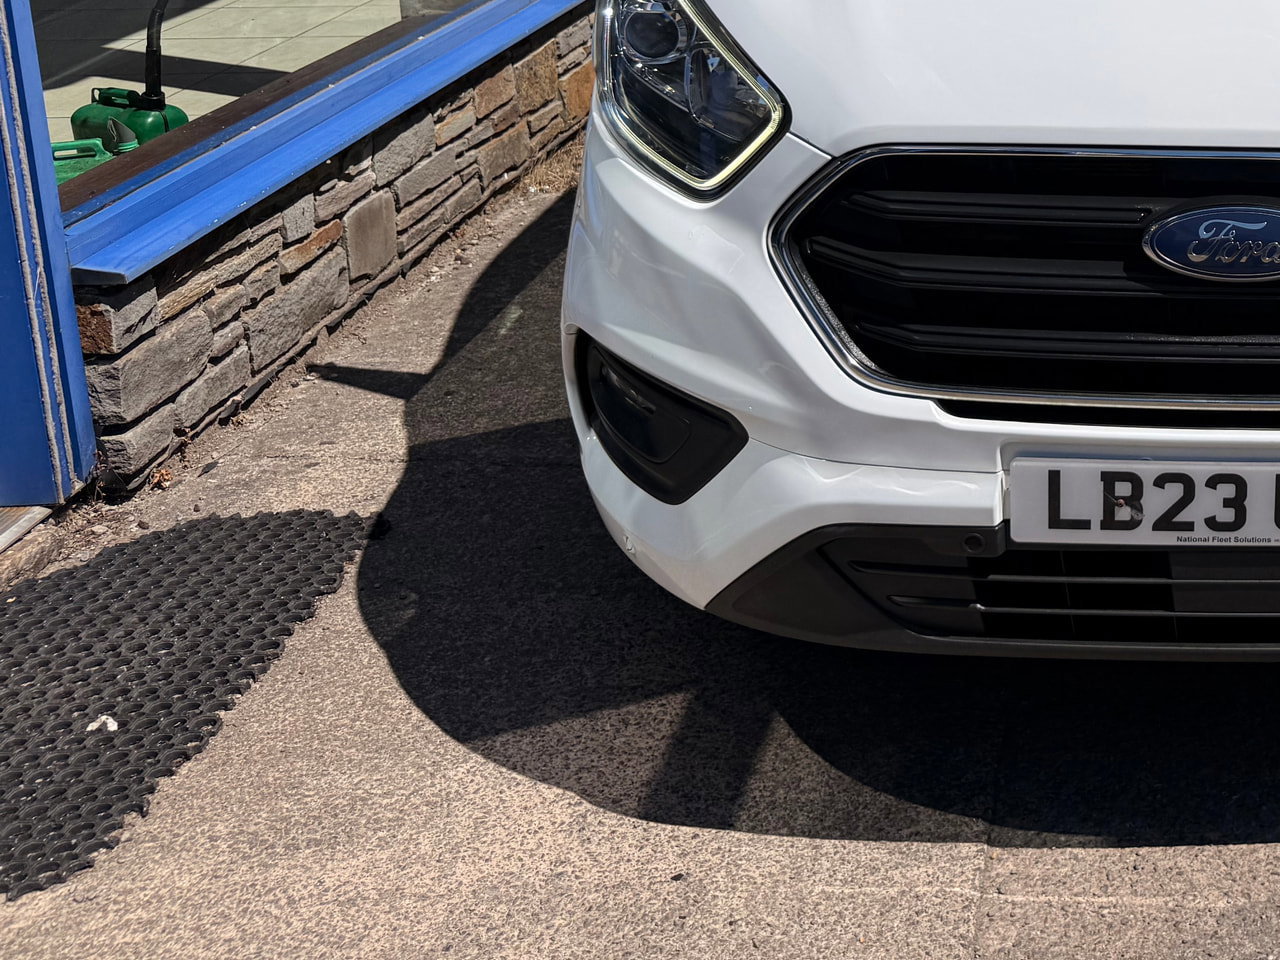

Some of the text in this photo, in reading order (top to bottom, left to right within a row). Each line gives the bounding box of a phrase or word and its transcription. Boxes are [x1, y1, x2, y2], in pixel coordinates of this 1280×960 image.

[1048, 470, 1248, 531] LB23
[1177, 535, 1210, 543] National
[1212, 535, 1232, 543] Fleet
[1234, 535, 1272, 543] Solutions
